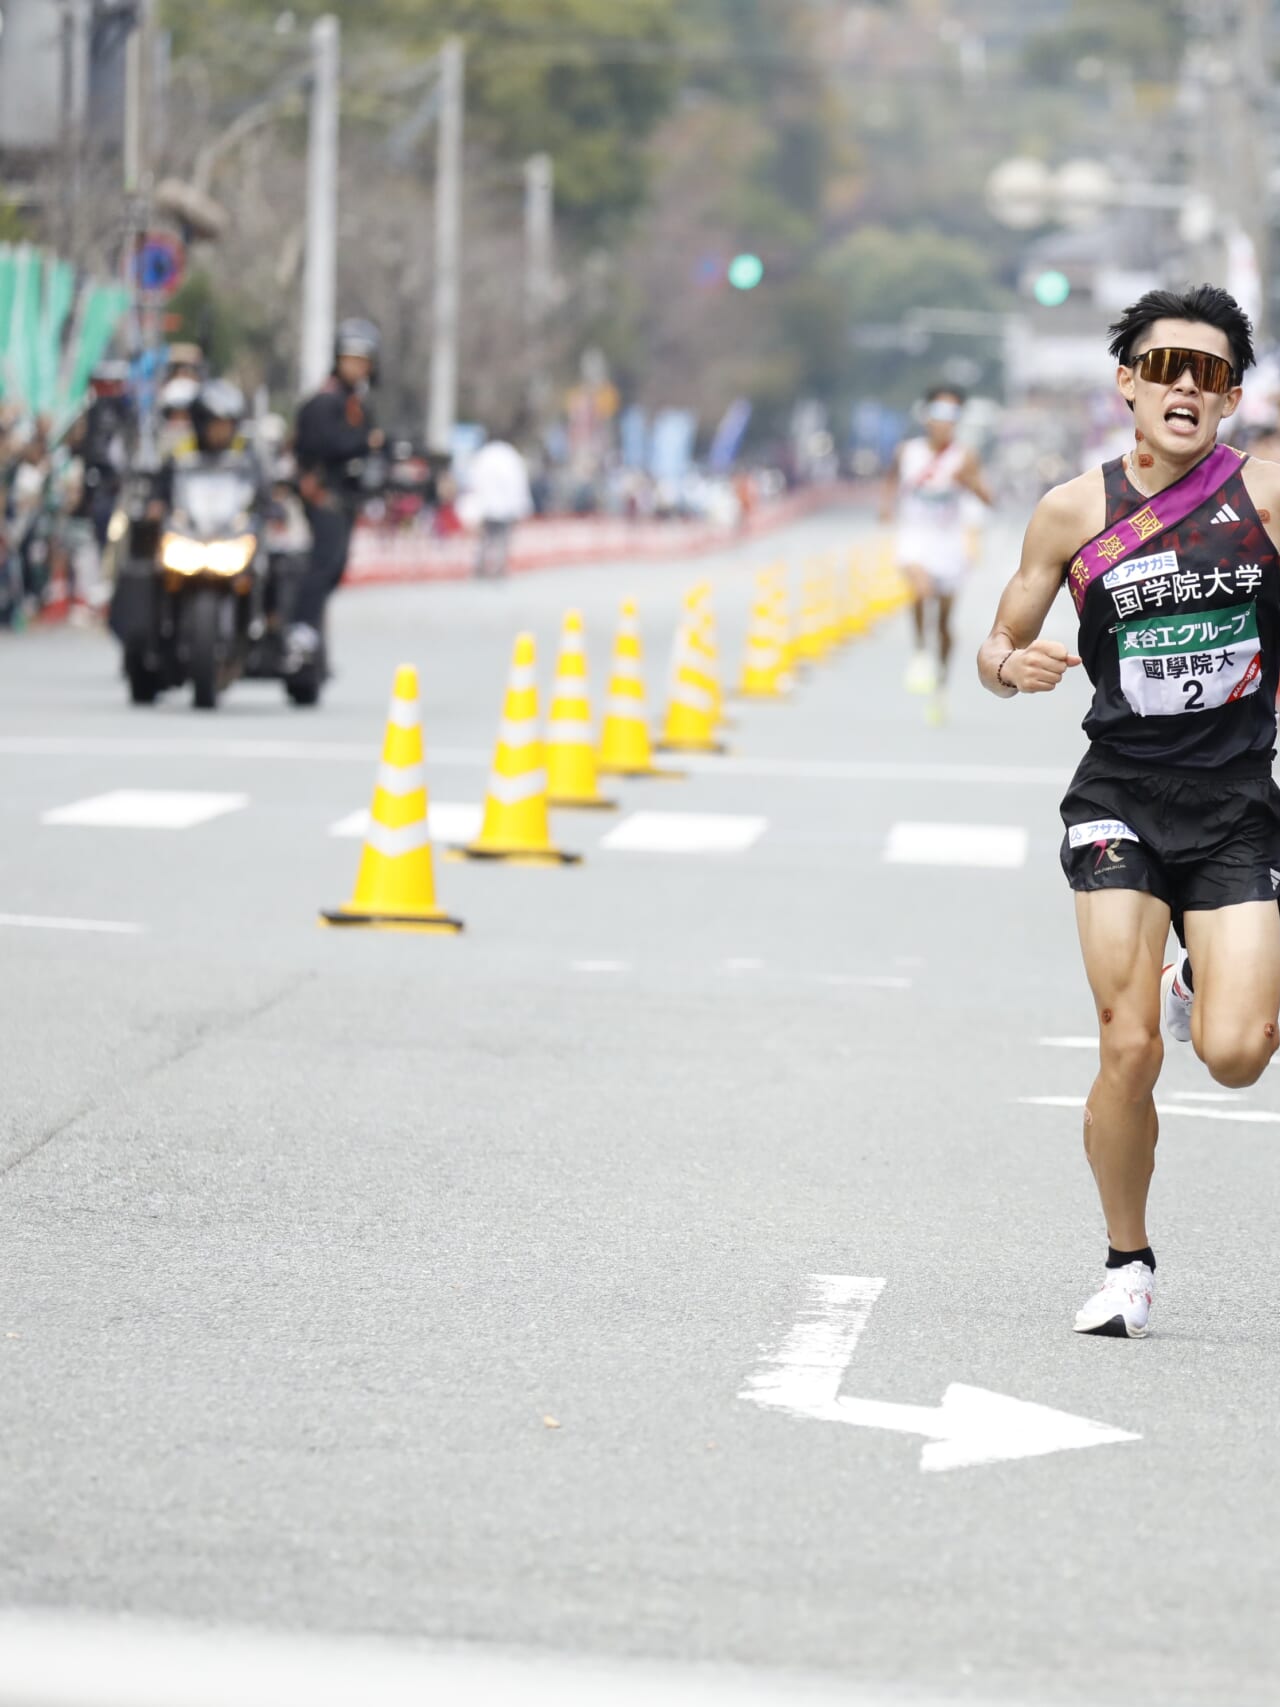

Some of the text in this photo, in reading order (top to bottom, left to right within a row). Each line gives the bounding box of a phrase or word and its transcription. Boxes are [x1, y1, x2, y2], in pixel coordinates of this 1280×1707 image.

[1123, 555, 1175, 578] アサガミ
[1111, 563, 1263, 619] 国学院大学
[1123, 610, 1250, 650] 長谷工グループ
[1142, 649, 1236, 680] 國學院大
[1182, 679, 1205, 710] 2
